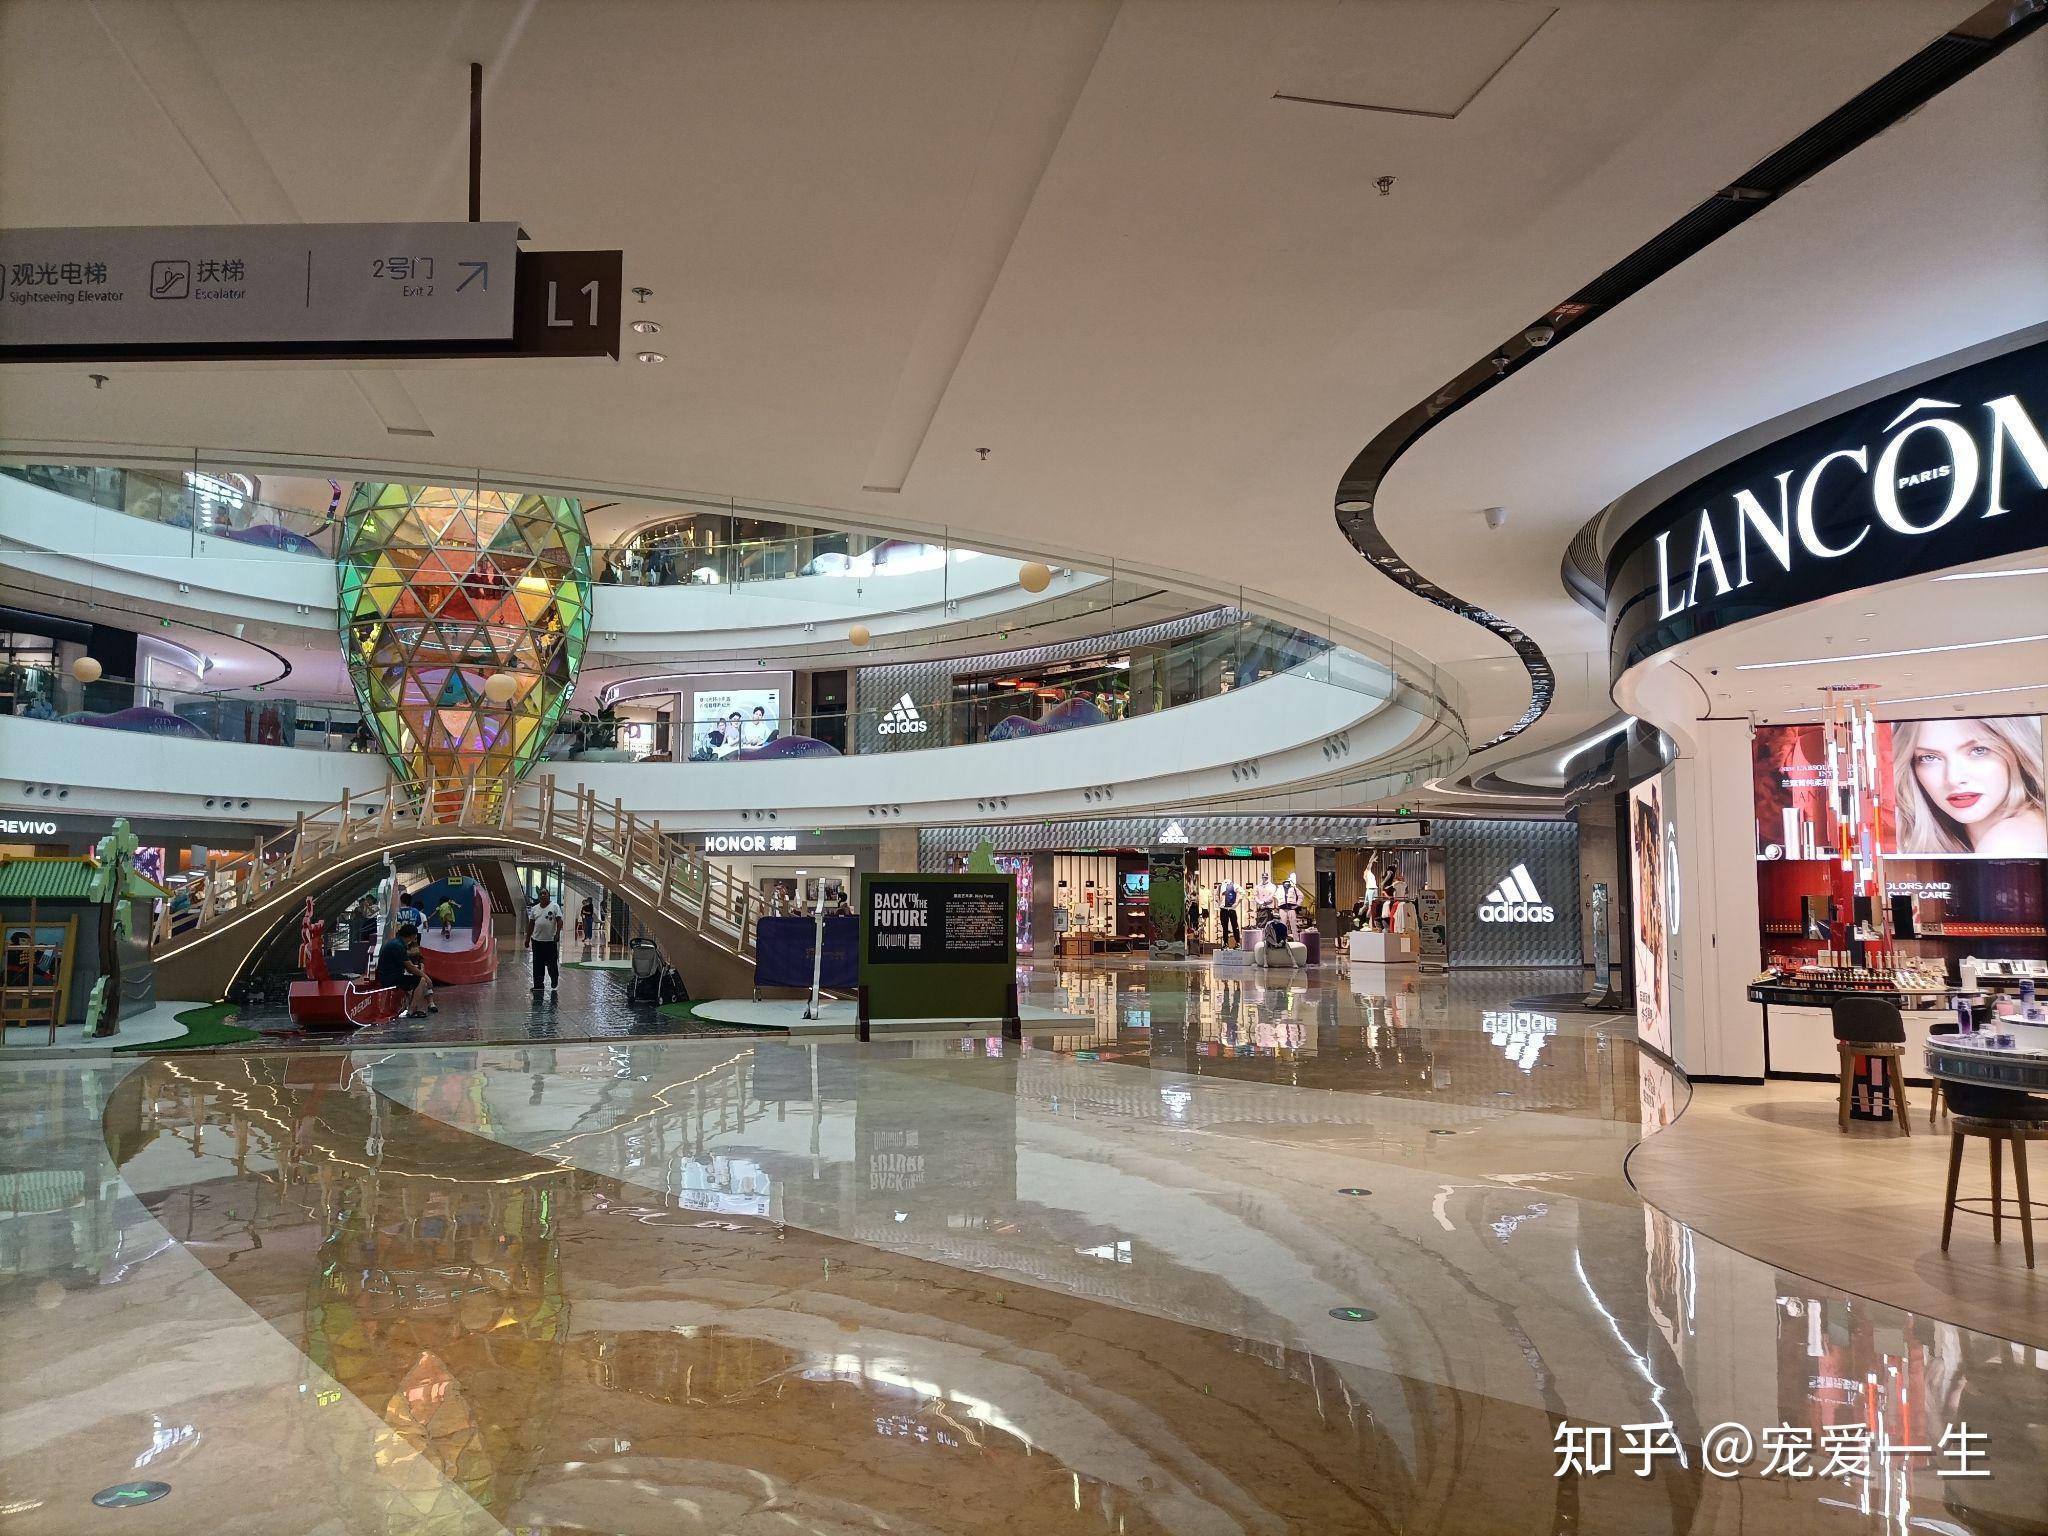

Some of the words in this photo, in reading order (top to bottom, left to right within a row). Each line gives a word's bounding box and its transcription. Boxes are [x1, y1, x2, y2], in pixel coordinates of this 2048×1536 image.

[10, 262, 108, 286] 观光电梯
[197, 259, 245, 283] 扶梯
[372, 256, 434, 280] 2号门
[10, 291, 75, 305] Sightseeing
[78, 290, 124, 302] Elevator
[195, 288, 246, 300] Escalator
[403, 286, 424, 297] Exit
[426, 286, 434, 296] 2
[547, 280, 599, 327] L1
[1899, 465, 1951, 490] PARIS
[877, 719, 927, 735] adidas
[705, 836, 766, 851] HONOR
[1159, 835, 1189, 843] adidas
[1886, 882, 1923, 890] OLORS
[1925, 882, 1951, 890] AND
[874, 893, 908, 909] BACK
[1919, 891, 1951, 899] CARE
[873, 909, 928, 927] FUTURE
[1479, 903, 1555, 923] adidas
